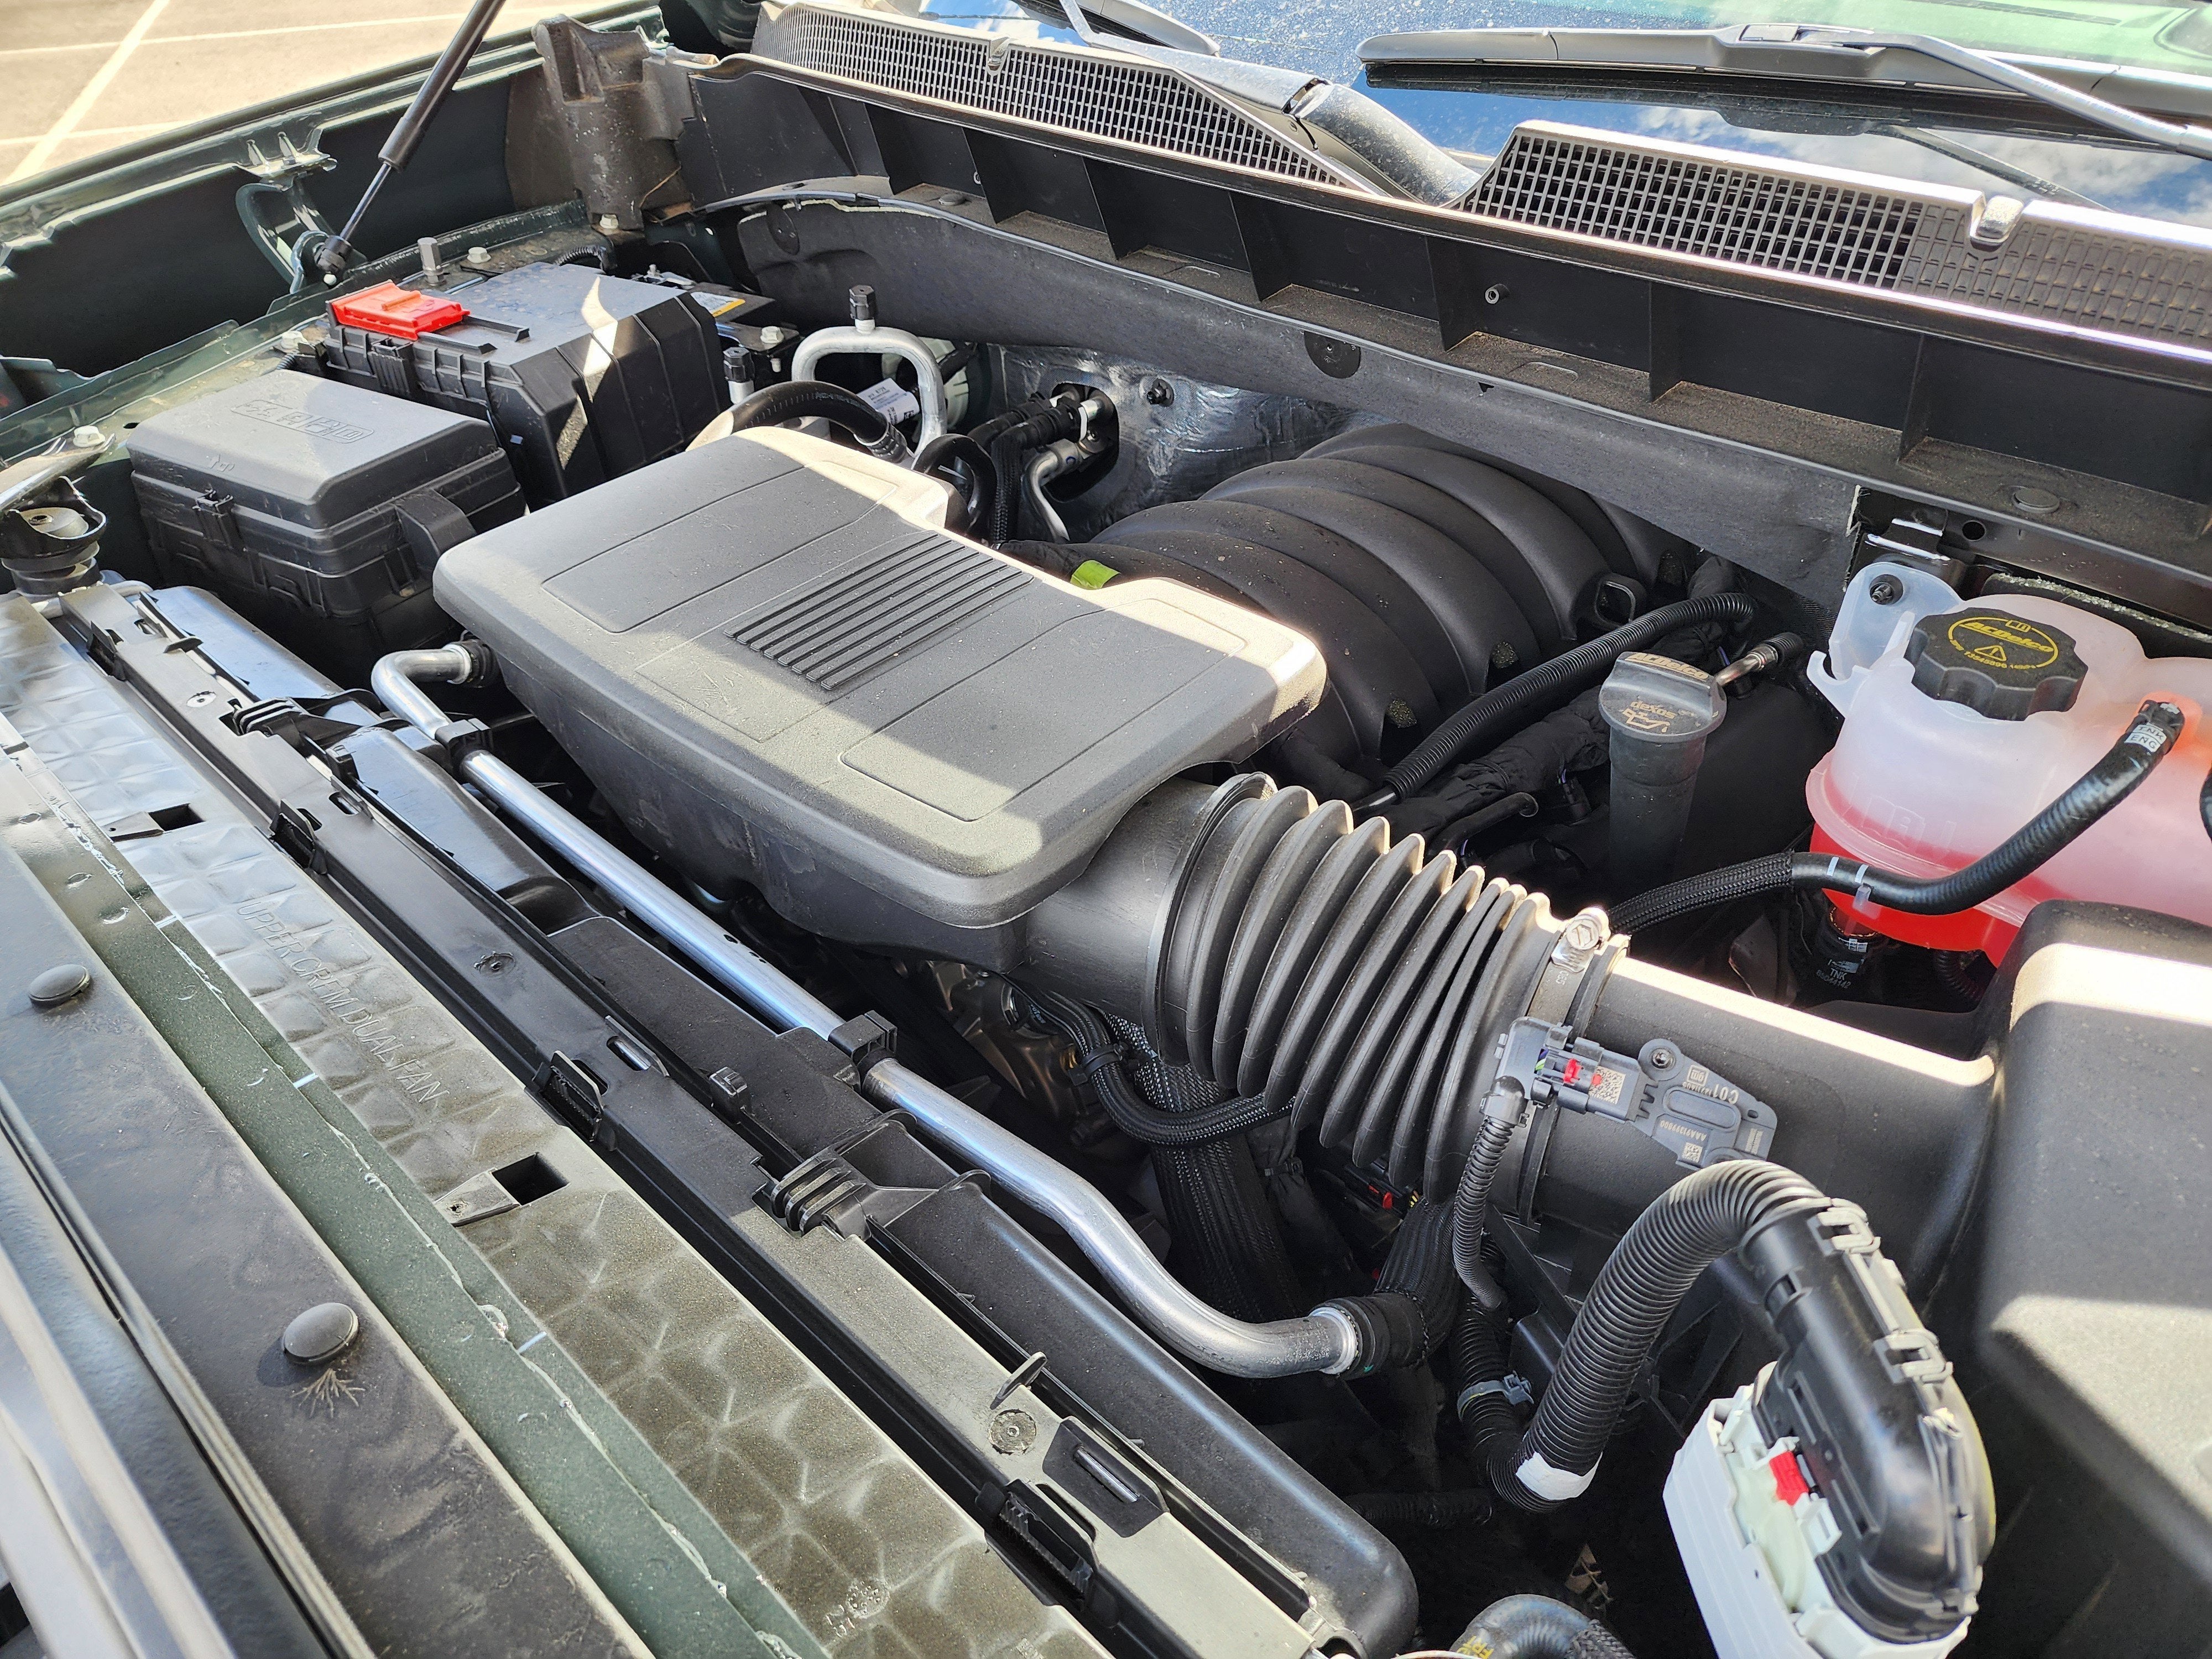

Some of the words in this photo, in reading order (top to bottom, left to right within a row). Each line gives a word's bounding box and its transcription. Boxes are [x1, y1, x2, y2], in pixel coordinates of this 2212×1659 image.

[1960, 621, 2054, 653] ACDelco
[1626, 652, 1709, 681] ACDelco
[1630, 701, 1677, 719] dexos
[2130, 734, 2158, 750] ENG
[2138, 726, 2165, 741] TNK
[1829, 968, 1848, 980] TNK
[236, 900, 307, 959] UPPER
[291, 956, 359, 1011] CRFM
[340, 1005, 404, 1064] DUAL
[388, 1057, 450, 1104] FAN
[1712, 1083, 1740, 1105] C01
